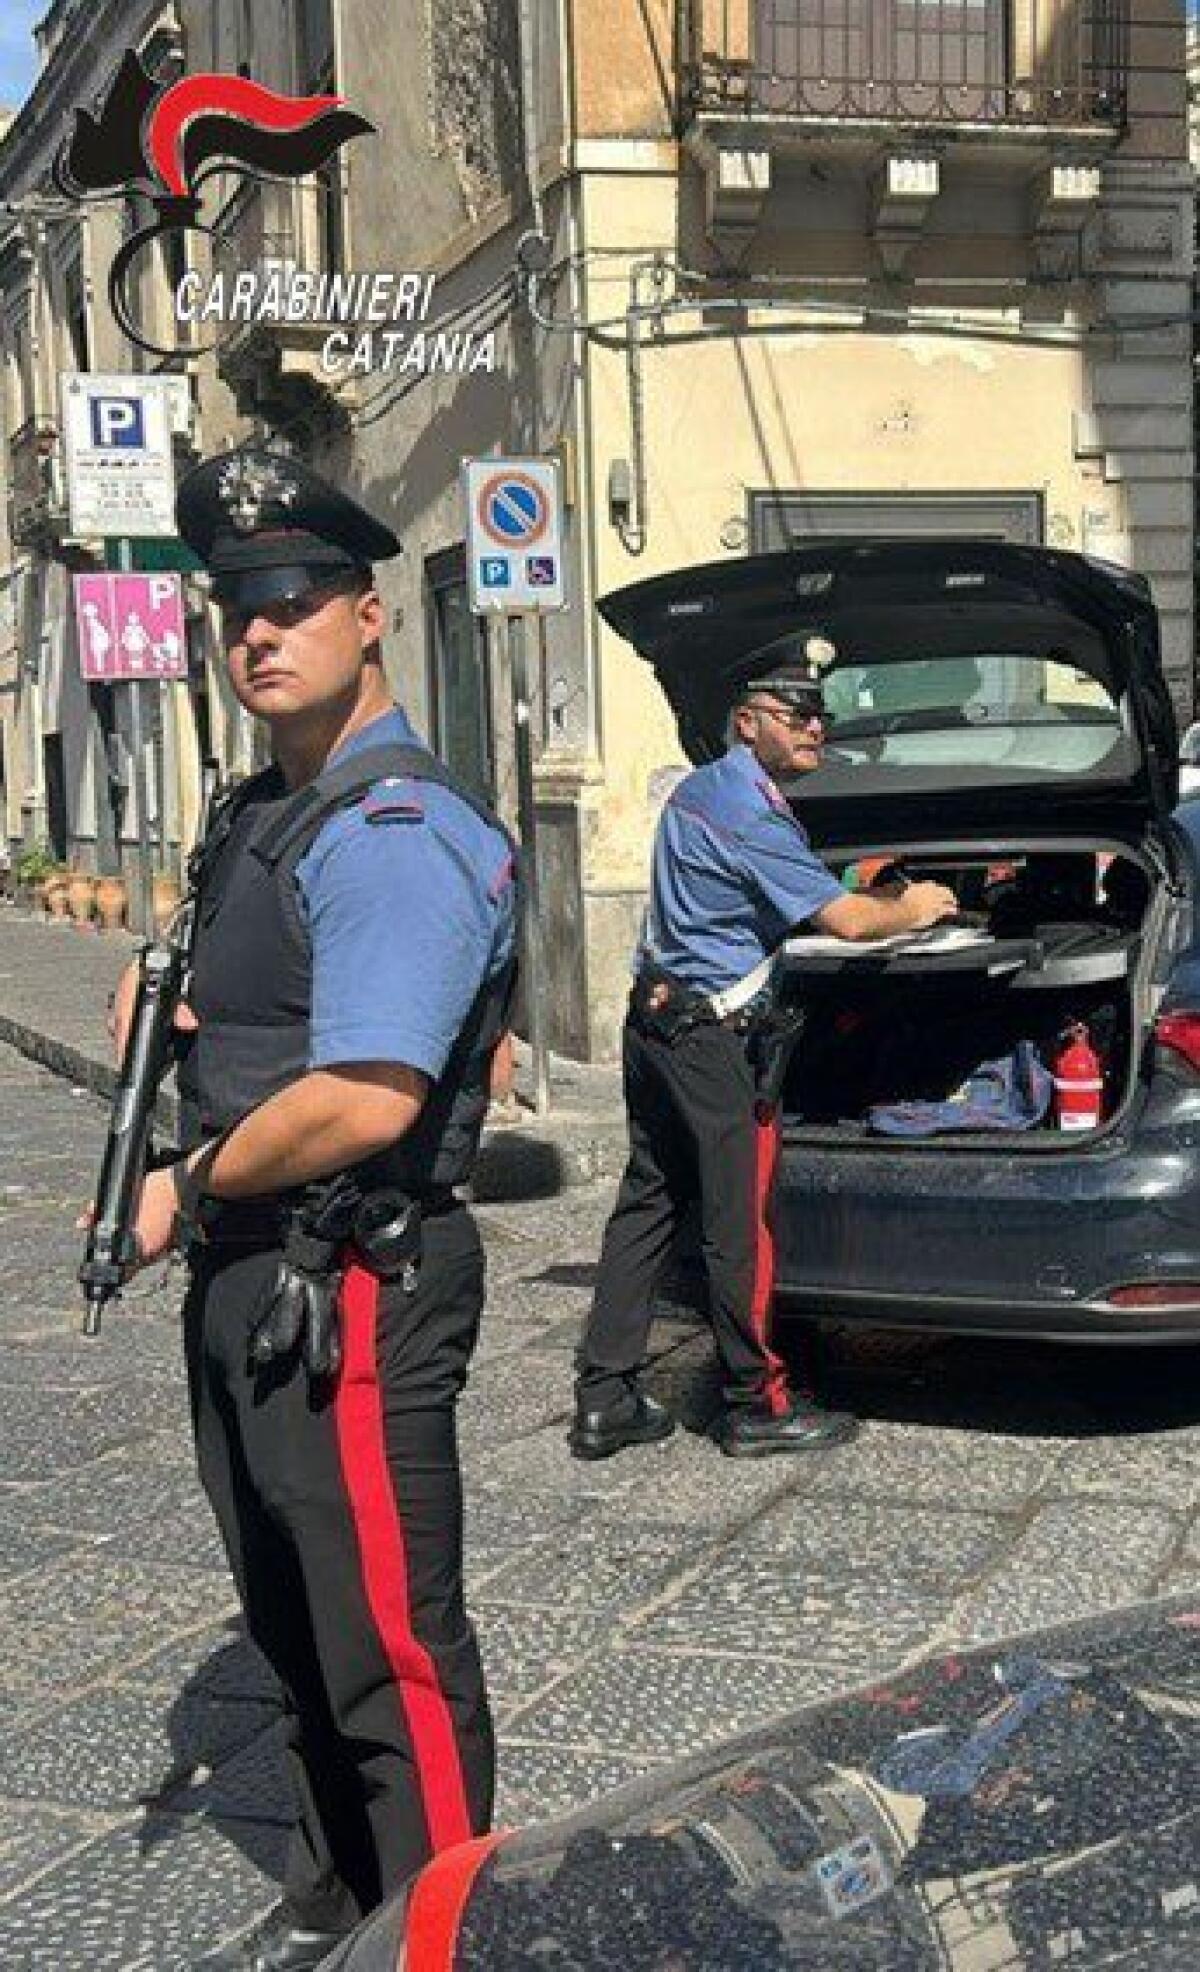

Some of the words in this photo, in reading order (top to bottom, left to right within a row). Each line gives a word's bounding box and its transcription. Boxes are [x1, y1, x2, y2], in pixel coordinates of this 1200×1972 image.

[100, 401, 135, 443] P
[487, 562, 505, 582] P
[150, 580, 175, 609] P
